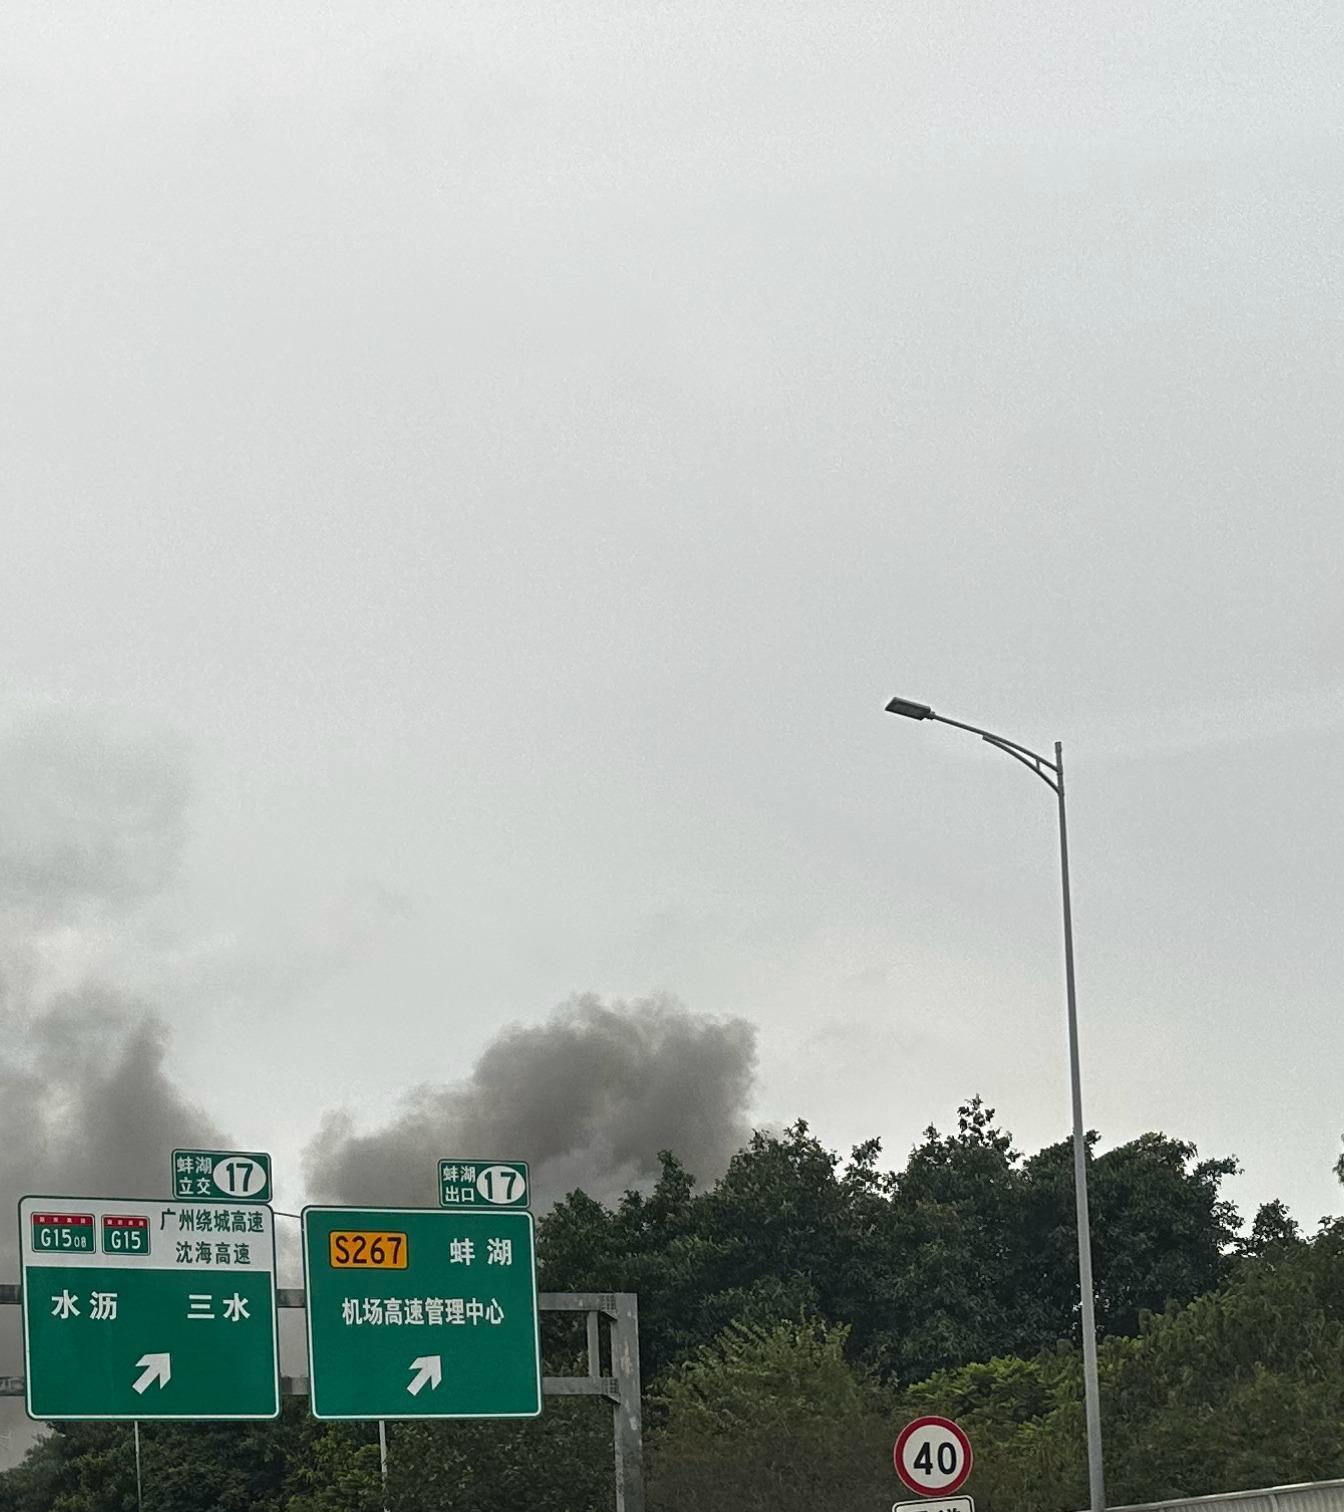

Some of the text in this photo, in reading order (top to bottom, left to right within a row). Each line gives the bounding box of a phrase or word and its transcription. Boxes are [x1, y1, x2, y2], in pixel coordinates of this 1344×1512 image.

[177, 1156, 212, 1175] 蚌湖
[226, 1162, 253, 1192] 17
[442, 1165, 476, 1183] 蚌湖
[178, 1177, 211, 1195] 立交
[445, 1185, 475, 1203] 出口
[484, 1171, 517, 1200] 17
[160, 1207, 265, 1233] 广州绕城高速
[110, 1230, 142, 1250] G15
[175, 1240, 252, 1265] 沈海高速
[335, 1235, 403, 1265] S267
[449, 1237, 513, 1267] 蚌湖
[50, 1289, 118, 1321] 水沥
[187, 1292, 252, 1323] 三水
[341, 1296, 505, 1326] 机场高速管理中心
[913, 1441, 957, 1476] 40
